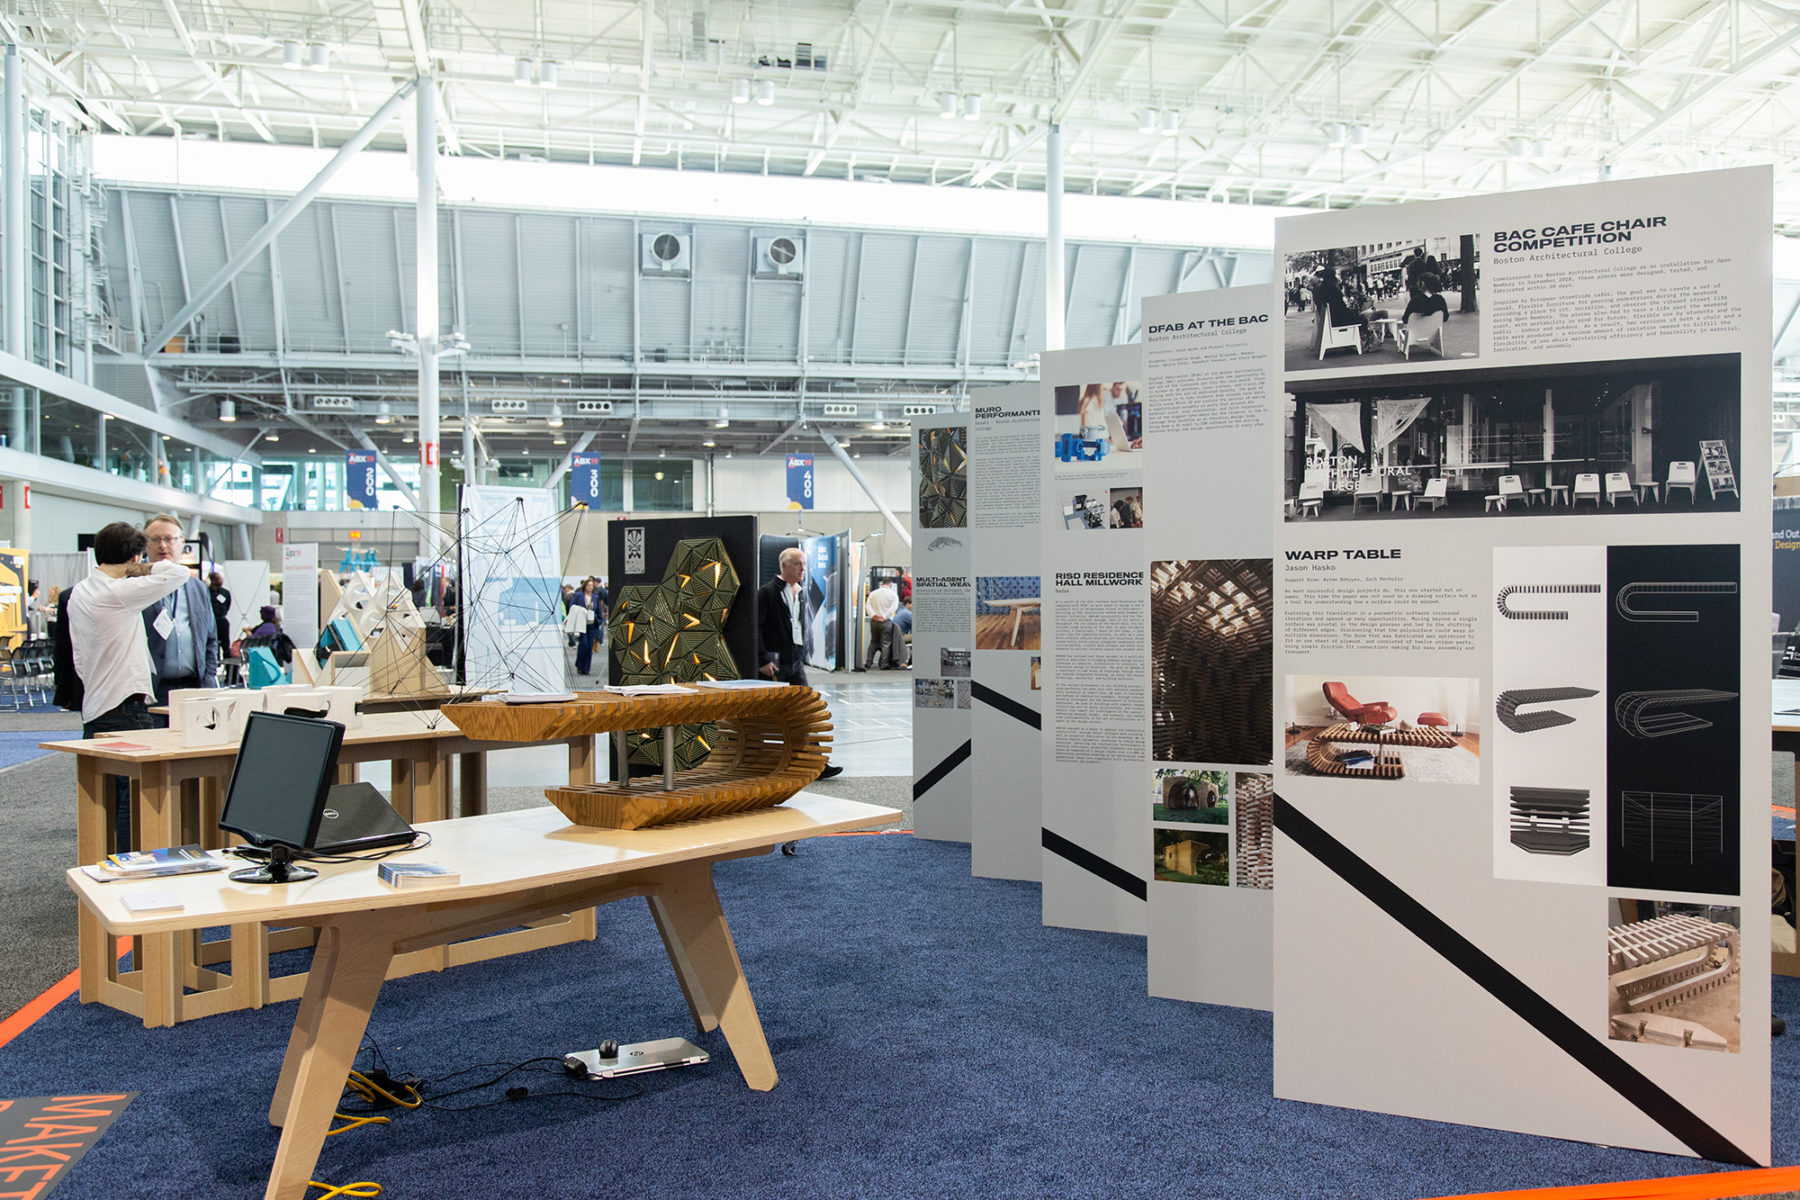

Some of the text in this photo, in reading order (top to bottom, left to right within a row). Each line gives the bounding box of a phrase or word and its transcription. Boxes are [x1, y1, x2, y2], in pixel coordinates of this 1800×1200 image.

[1494, 216, 1667, 242] BAC CAFE CHAIR
[1494, 231, 1631, 253] COMPETITION
[1494, 245, 1642, 265] Boston Architectural College
[1149, 315, 1268, 333] DFAB AT THE BAC
[1173, 330, 1217, 340] Architectural
[349, 454, 375, 464] ABX19
[574, 457, 598, 466] ABX19
[788, 458, 811, 467] ABX19
[366, 467, 374, 496] 200
[1285, 549, 1401, 560] WARP TABLE
